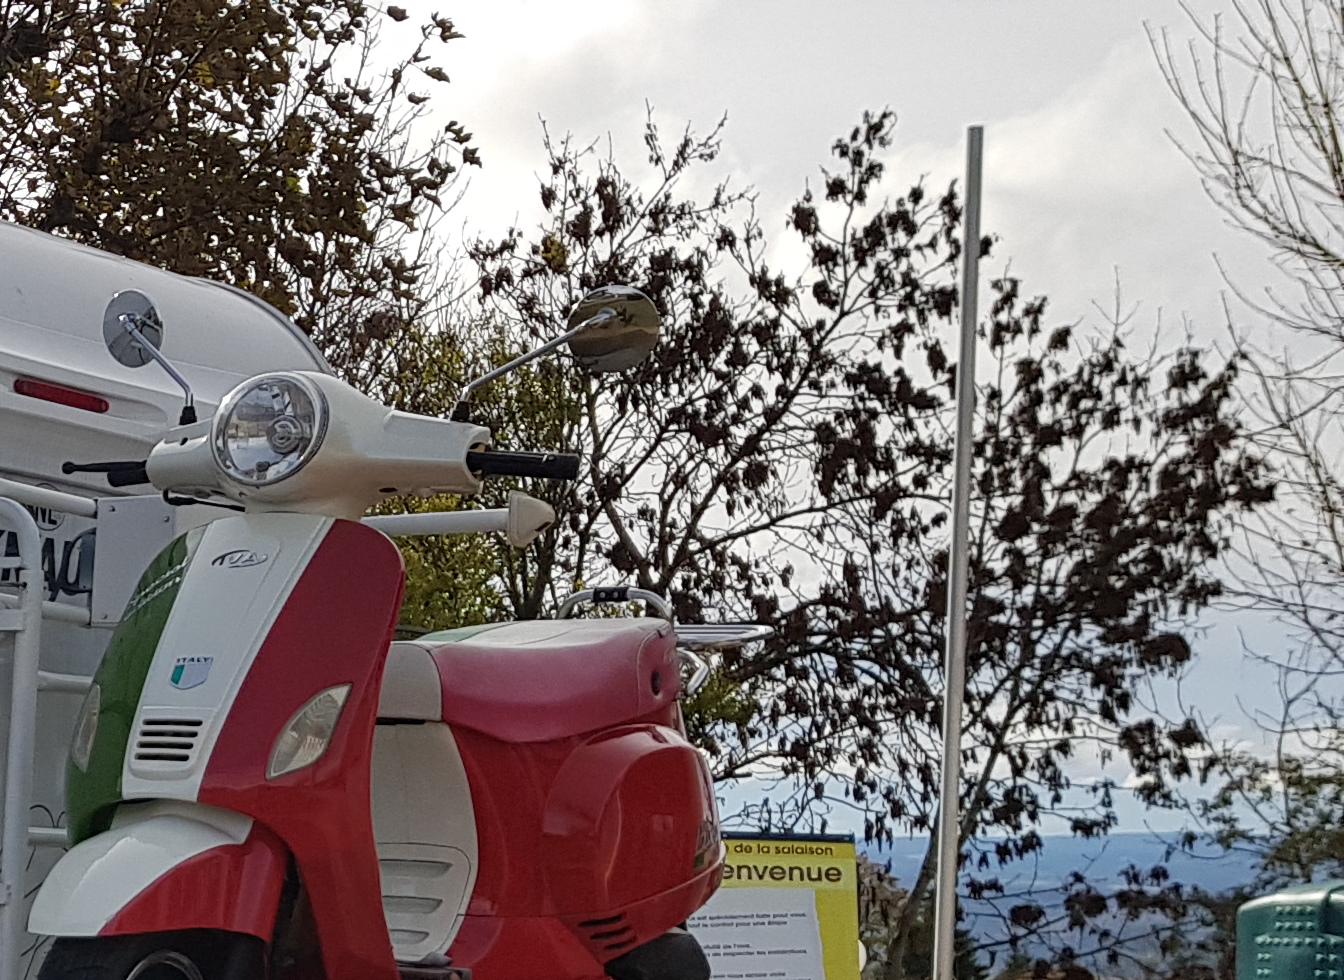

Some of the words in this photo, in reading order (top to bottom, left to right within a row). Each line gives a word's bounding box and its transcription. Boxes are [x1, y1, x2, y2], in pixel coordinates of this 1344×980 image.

[734, 843, 753, 854] de
[758, 844, 771, 854] la
[775, 844, 833, 856] salaison
[723, 864, 842, 882] envenue
